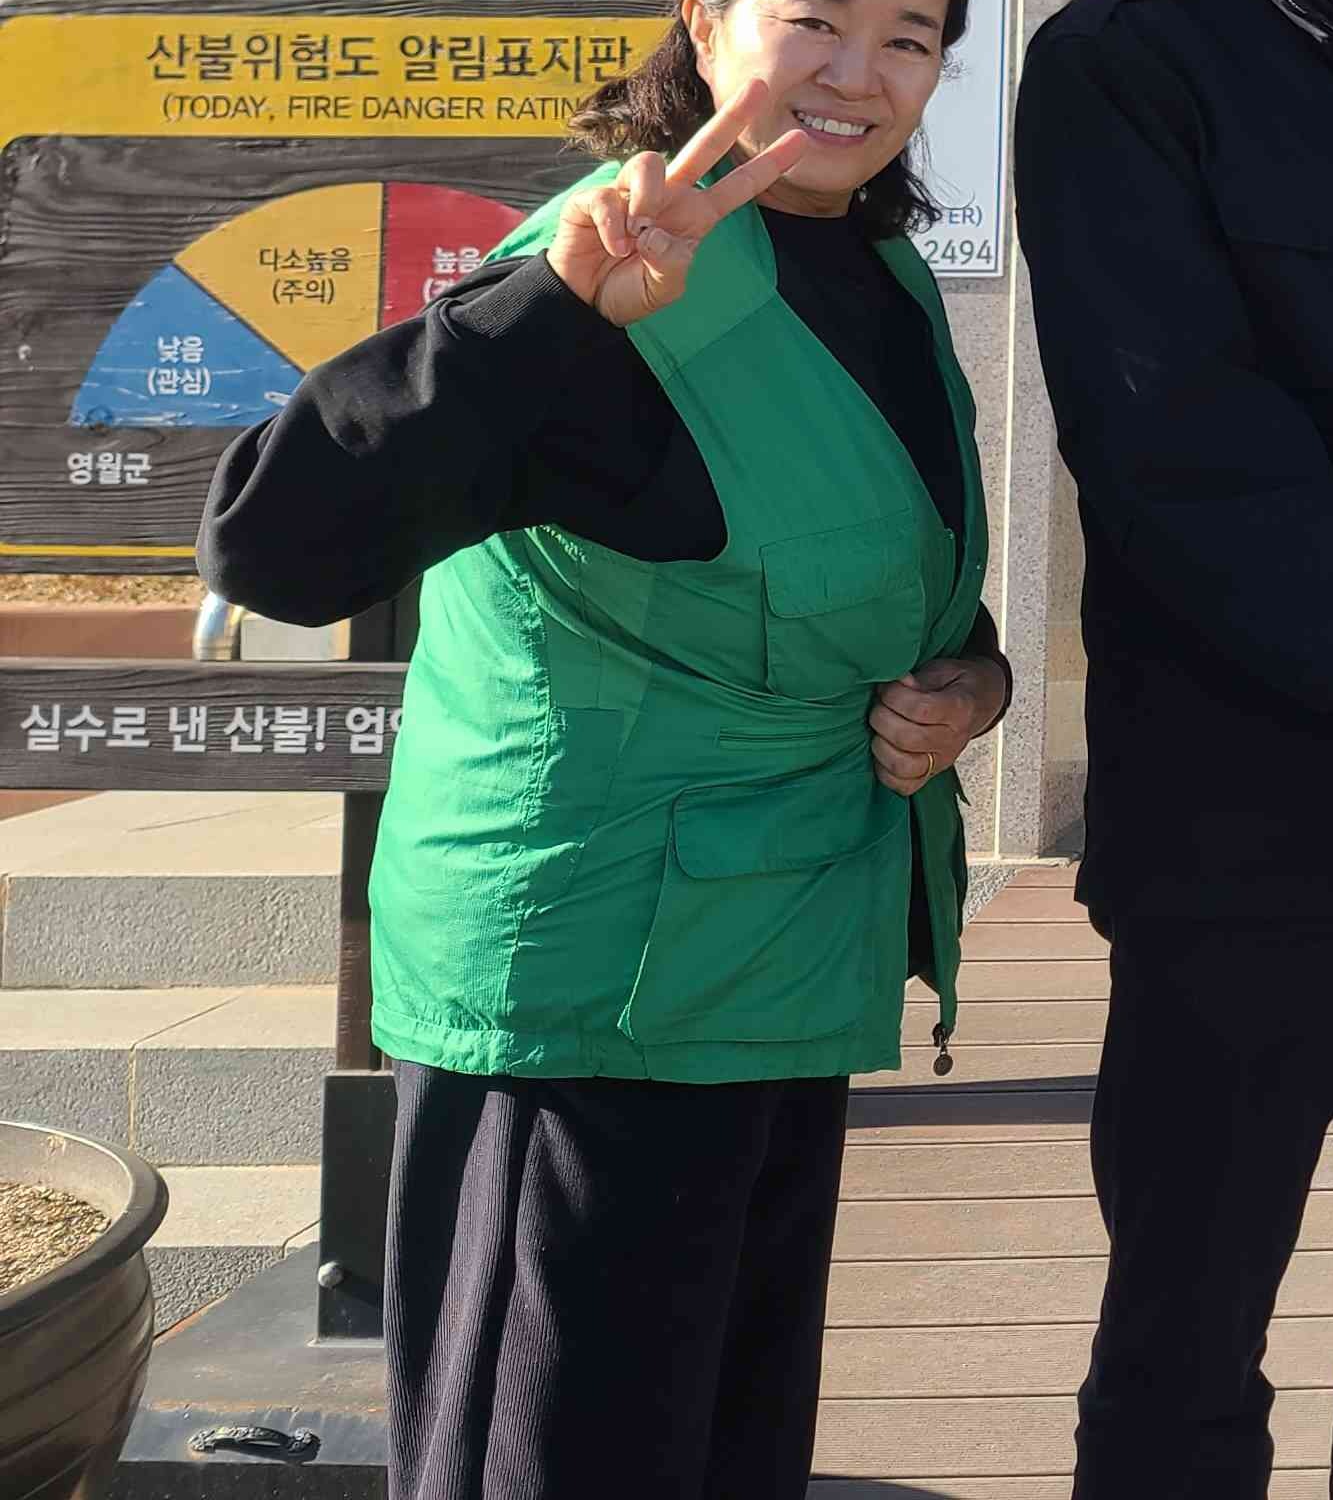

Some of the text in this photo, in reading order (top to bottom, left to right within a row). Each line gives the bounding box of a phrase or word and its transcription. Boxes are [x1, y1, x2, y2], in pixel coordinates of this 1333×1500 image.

[146, 33, 633, 83] 산불위험도 알림표지판
[288, 96, 352, 120] FIRE
[362, 96, 484, 120] DANGER
[496, 96, 582, 120] RATIN
[259, 247, 351, 273] 다소높음
[433, 246, 482, 274] 높음
[271, 277, 336, 305] (주의)
[157, 335, 205, 364] 낮음
[146, 365, 212, 397] (관심)
[66, 452, 151, 485] 영월군
[20, 703, 151, 753] 실수로
[167, 705, 208, 753] 낸
[223, 705, 328, 753] 산불!
